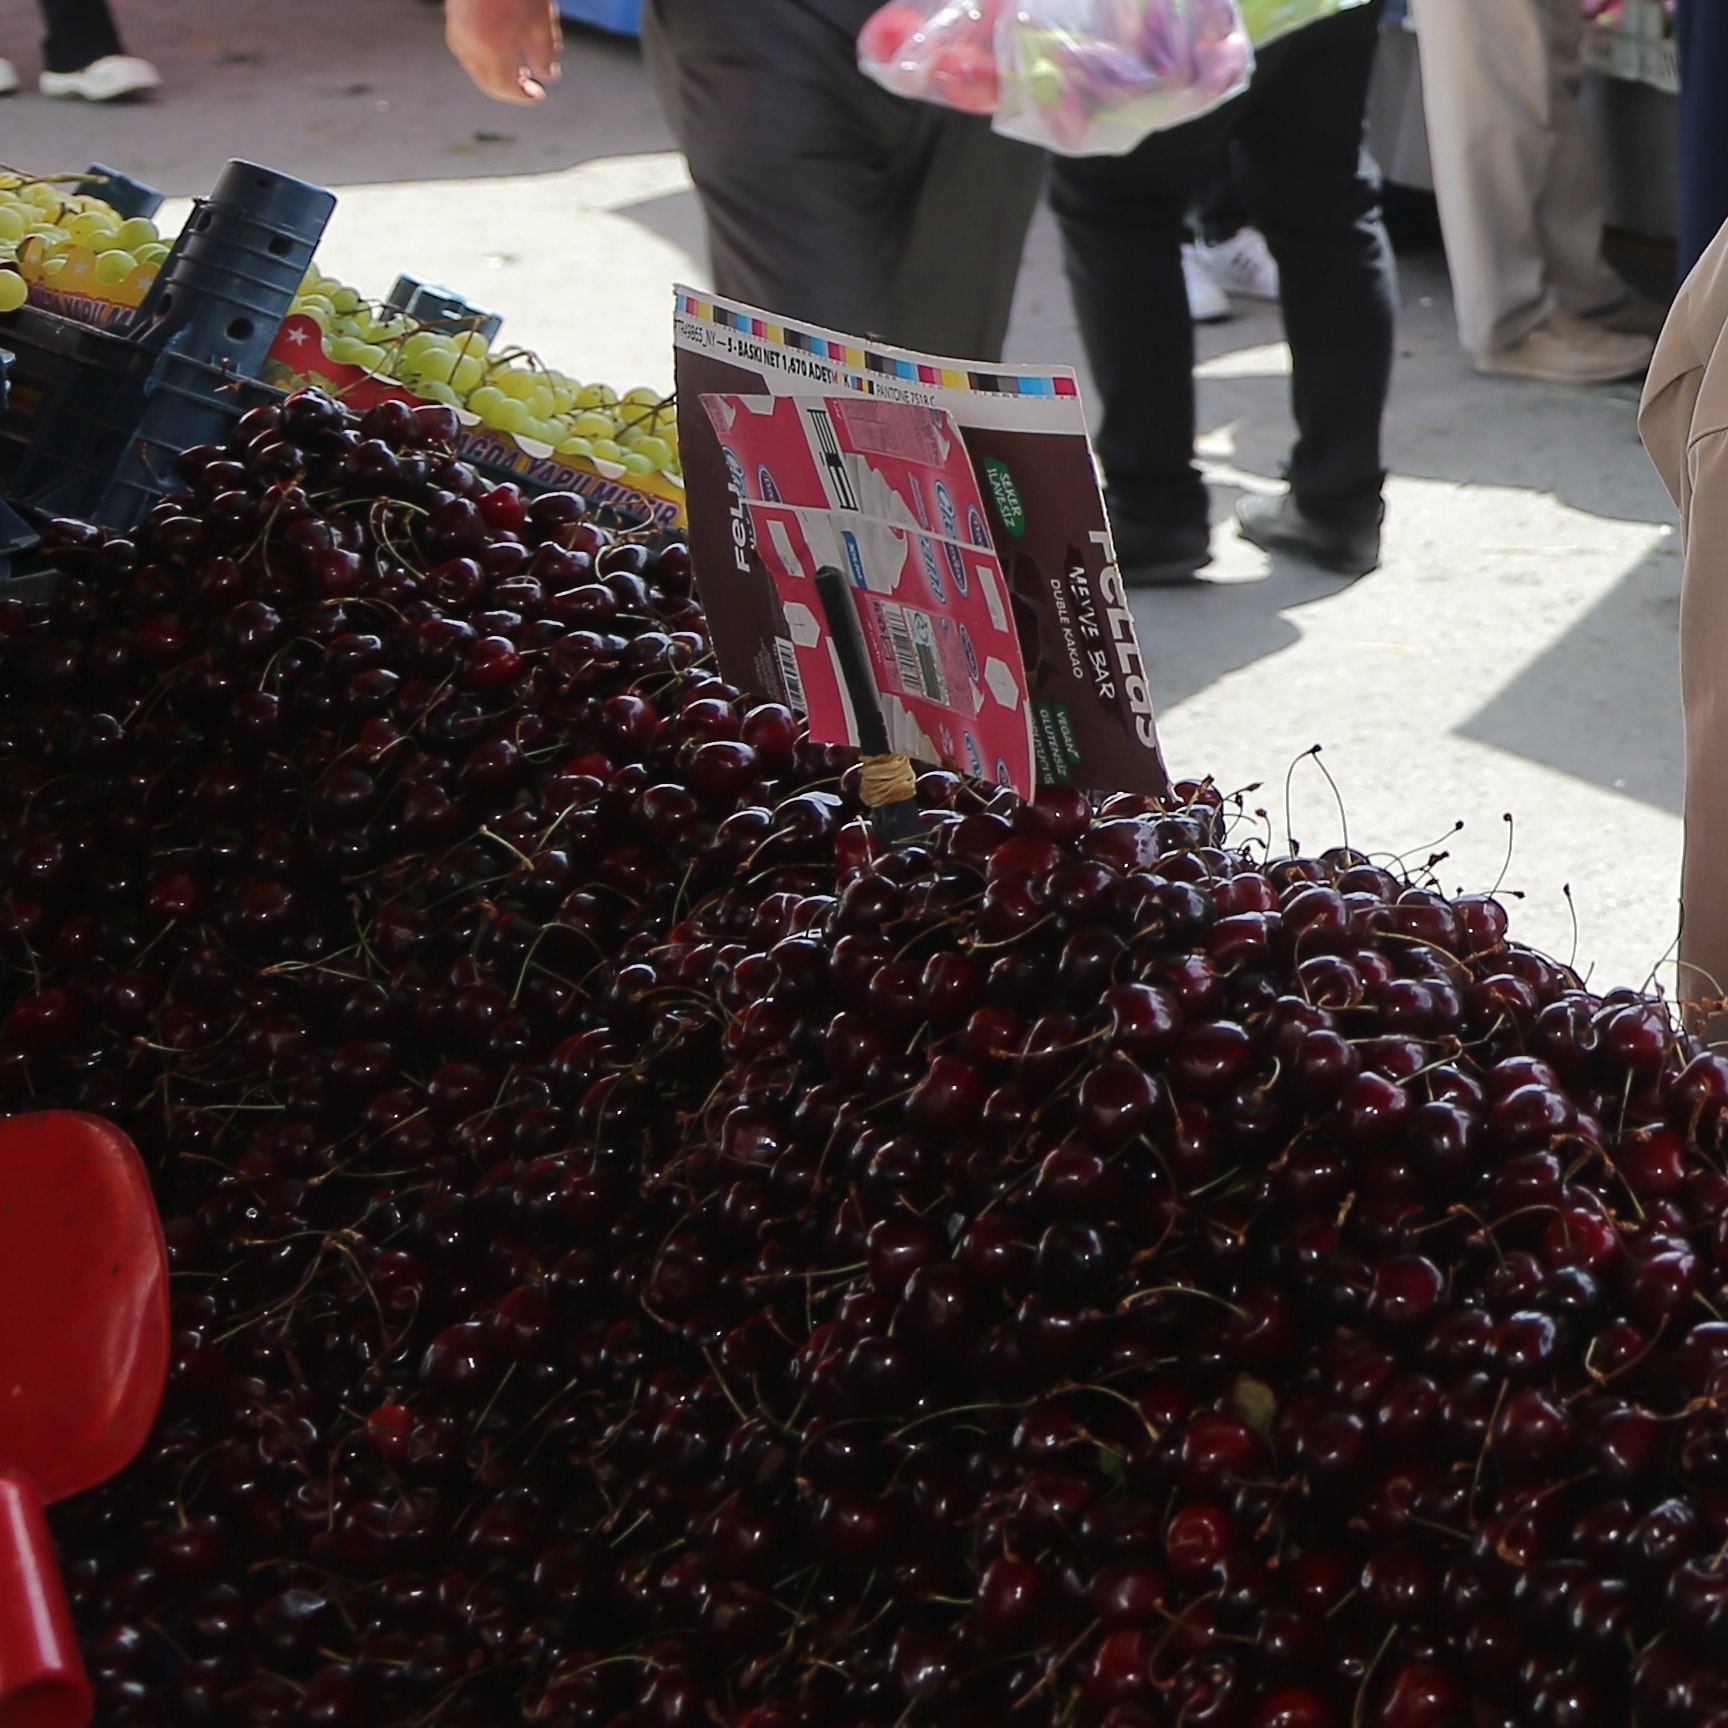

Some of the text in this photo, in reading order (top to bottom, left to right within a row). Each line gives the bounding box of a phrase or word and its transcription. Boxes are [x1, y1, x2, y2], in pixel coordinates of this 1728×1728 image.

[763, 348, 780, 368] NET
[875, 384, 911, 403] PANTONE
[1050, 577, 1084, 680] DUBLE KAKAO
[1087, 648, 1116, 701] BAR
[1055, 710, 1080, 763] VEGAN
